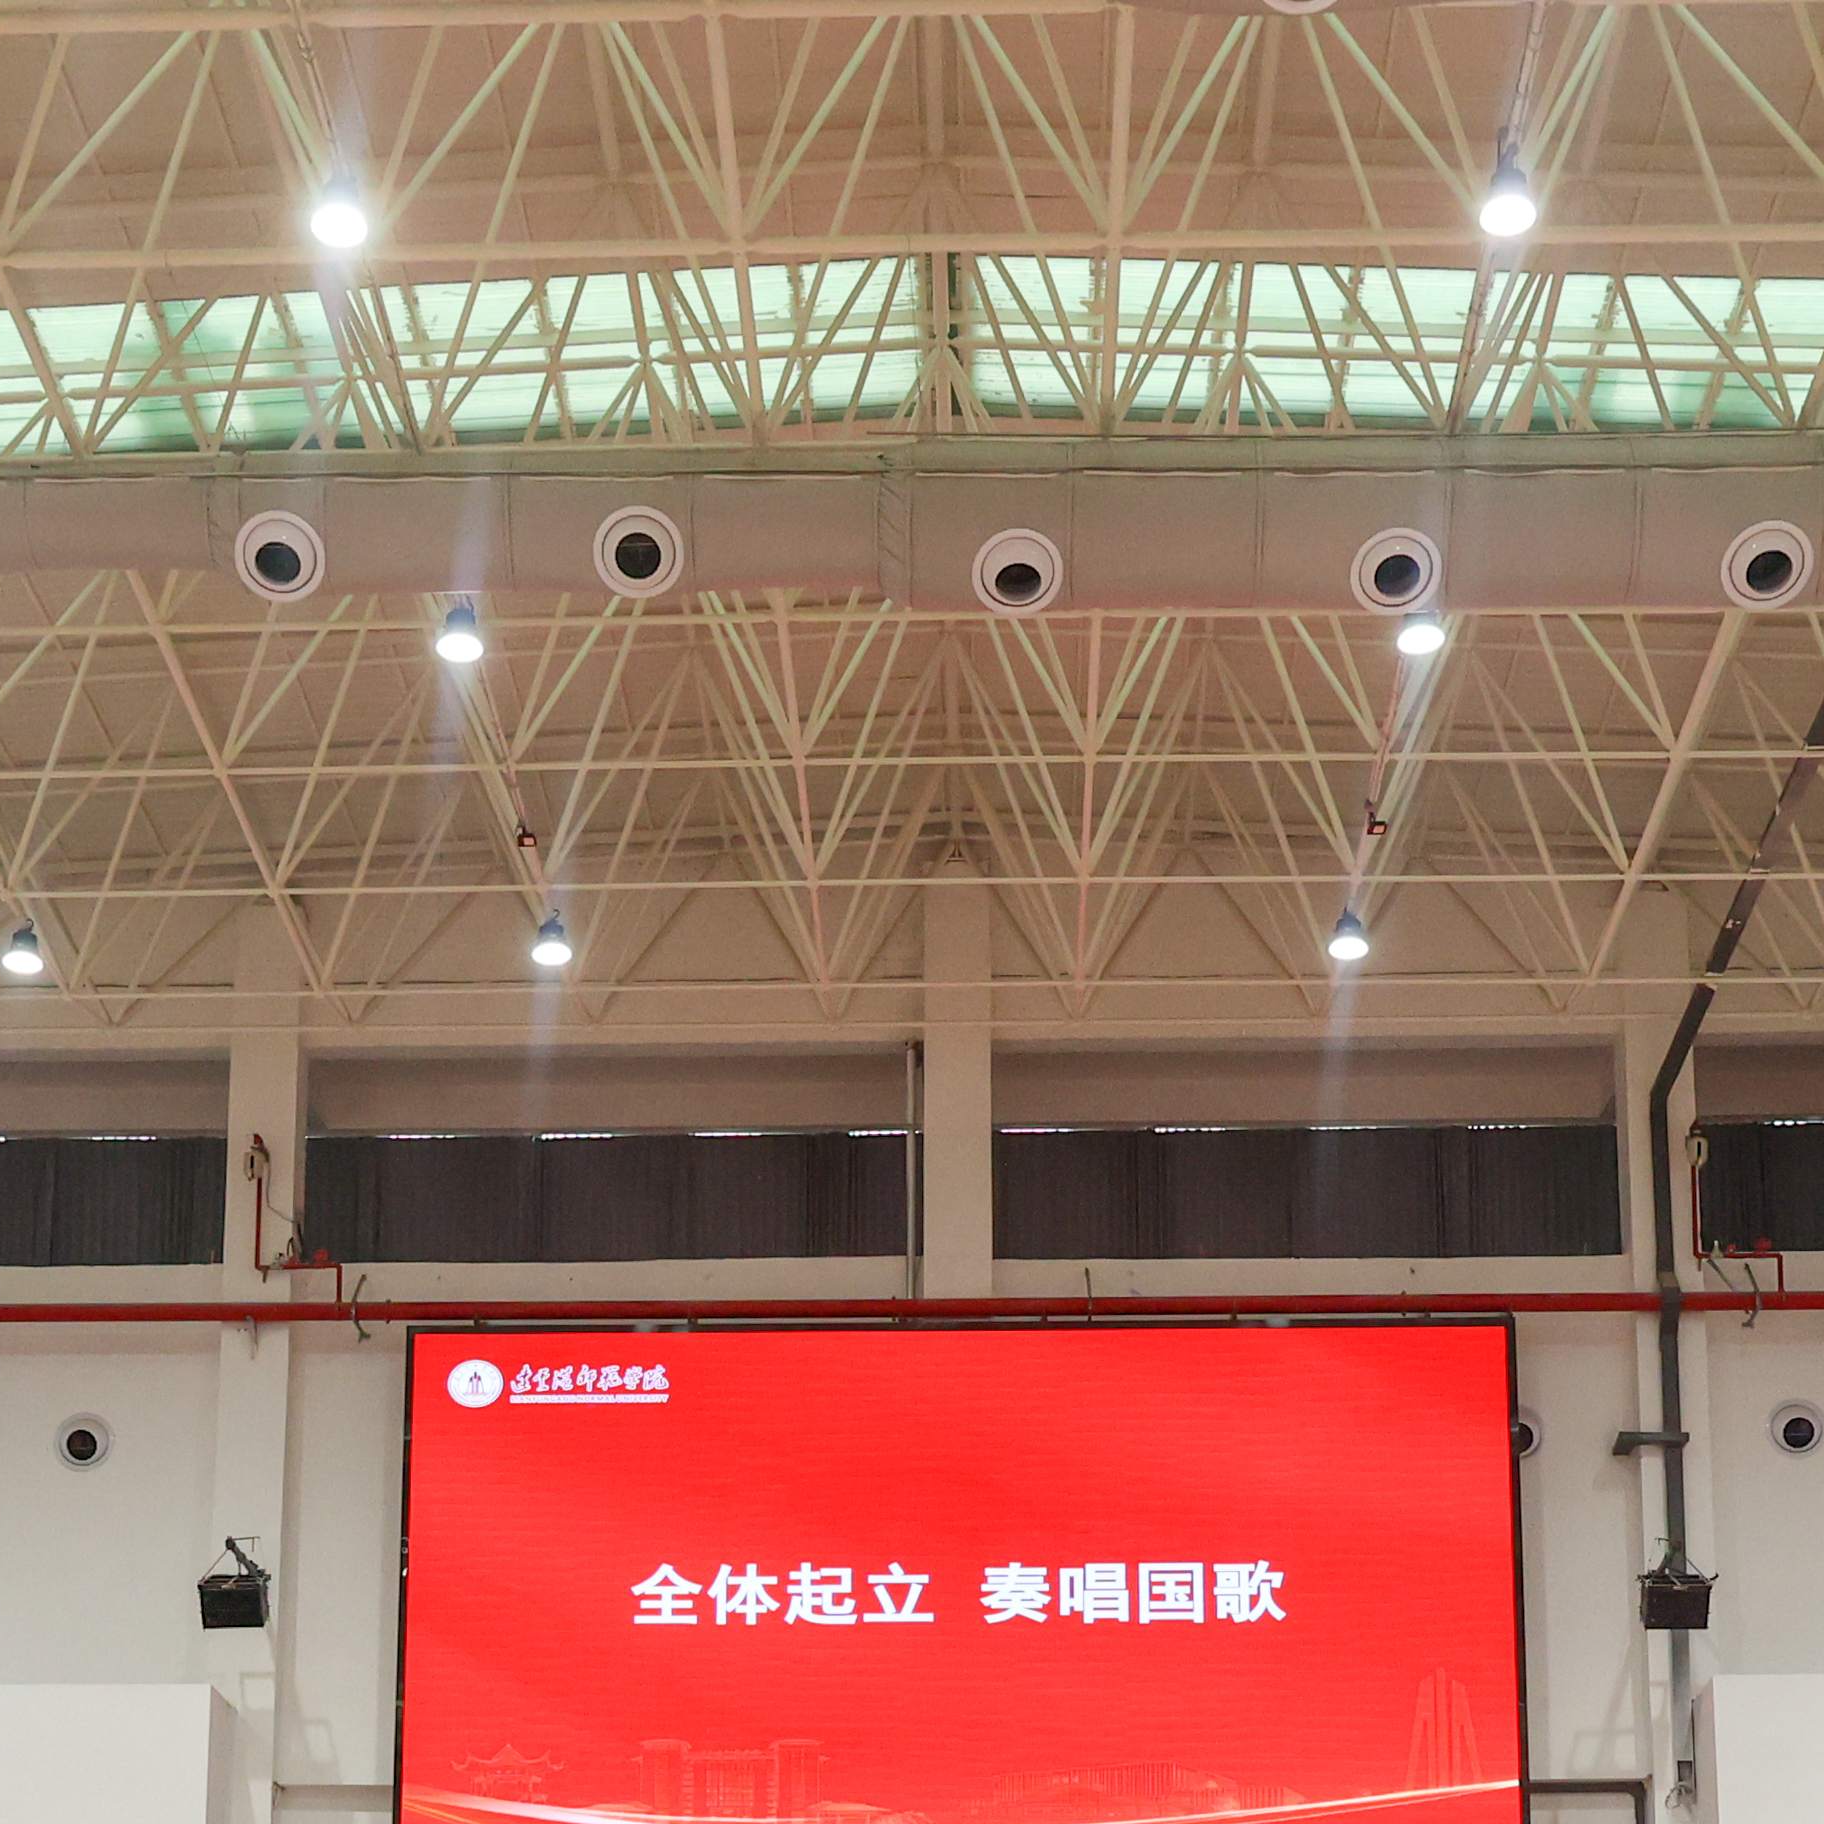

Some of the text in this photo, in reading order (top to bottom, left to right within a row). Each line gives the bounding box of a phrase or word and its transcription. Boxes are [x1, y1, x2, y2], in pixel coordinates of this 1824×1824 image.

[631, 1559, 1286, 1627] 全体起立 奏唱国歌
